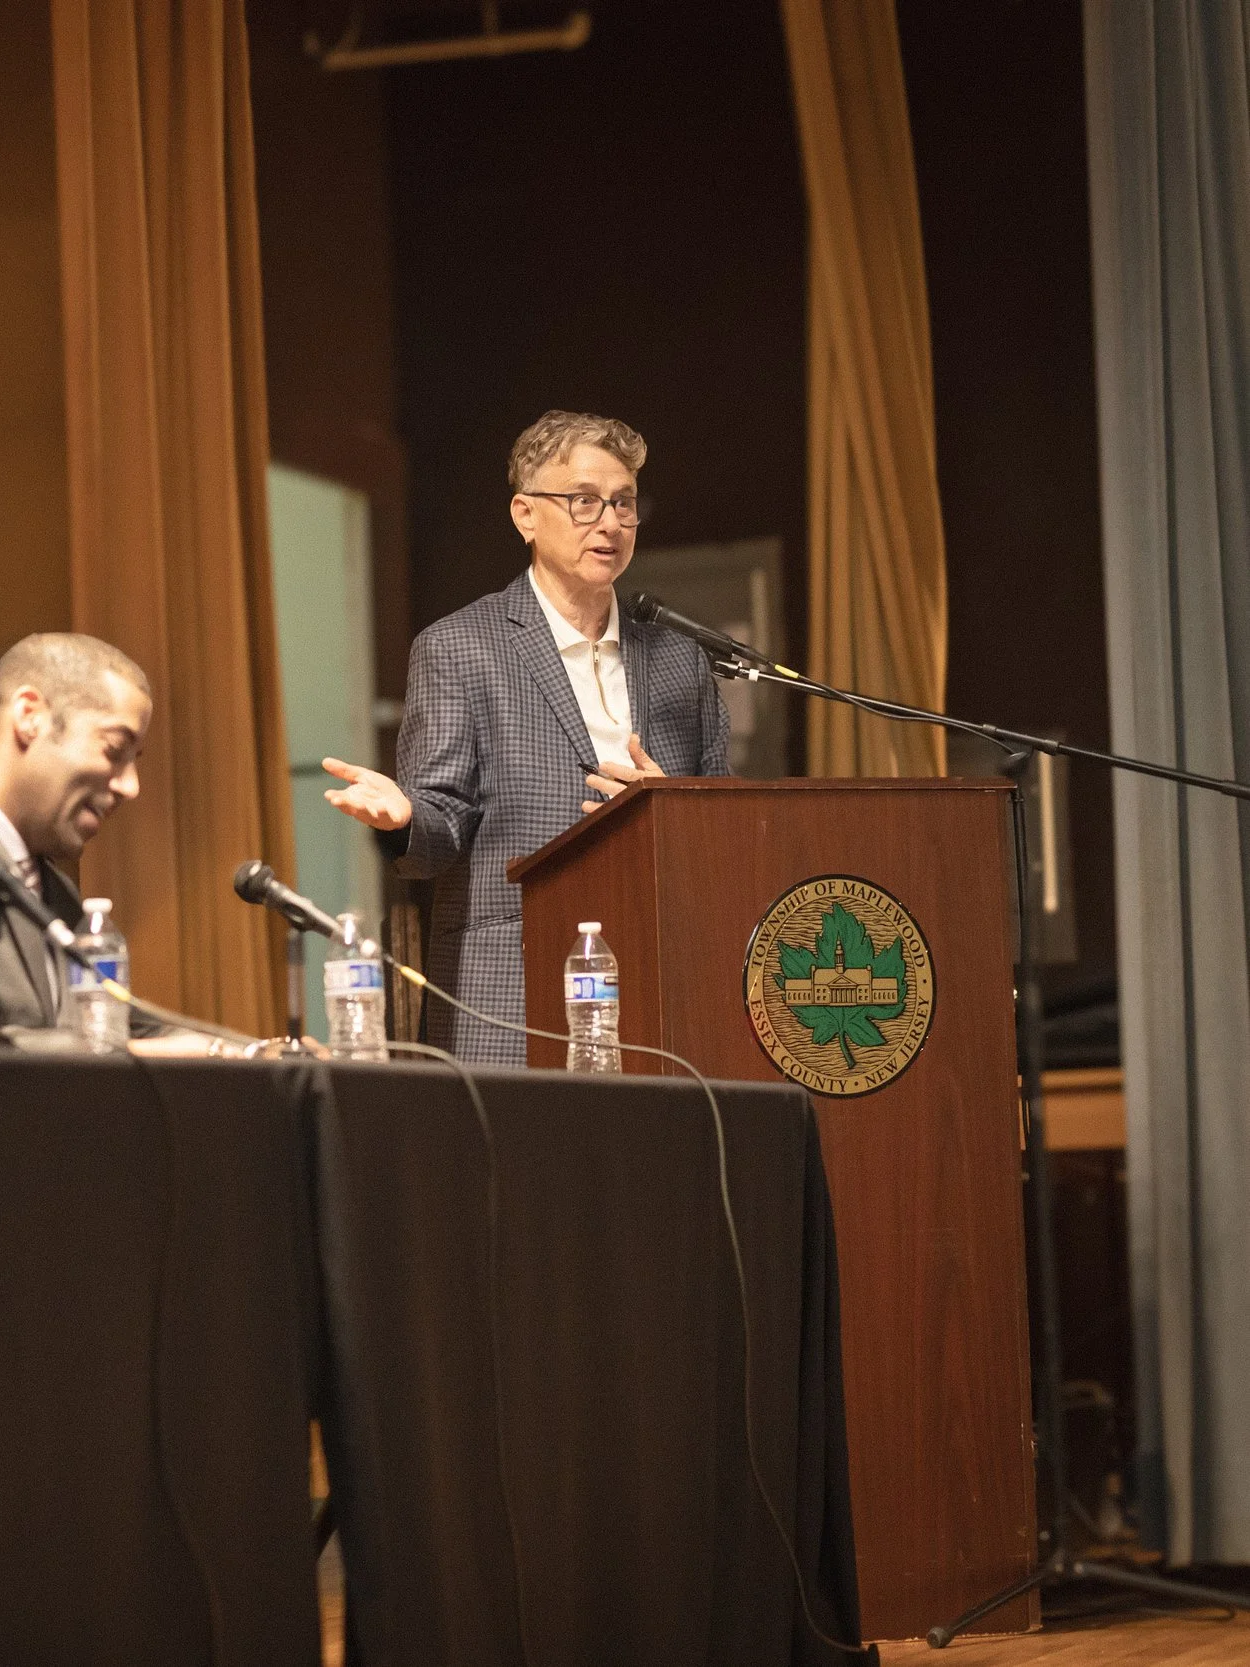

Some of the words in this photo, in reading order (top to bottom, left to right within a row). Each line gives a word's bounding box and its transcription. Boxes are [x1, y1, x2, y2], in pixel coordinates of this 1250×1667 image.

[751, 887, 809, 969] TOWNSHIP
[814, 881, 837, 896] OF
[842, 882, 926, 968] MAPLEWOOD
[750, 999, 782, 1052] ESSEX
[780, 1055, 848, 1093] COUNTY
[865, 1059, 899, 1088] NEW
[903, 996, 930, 1062] JERSEY
